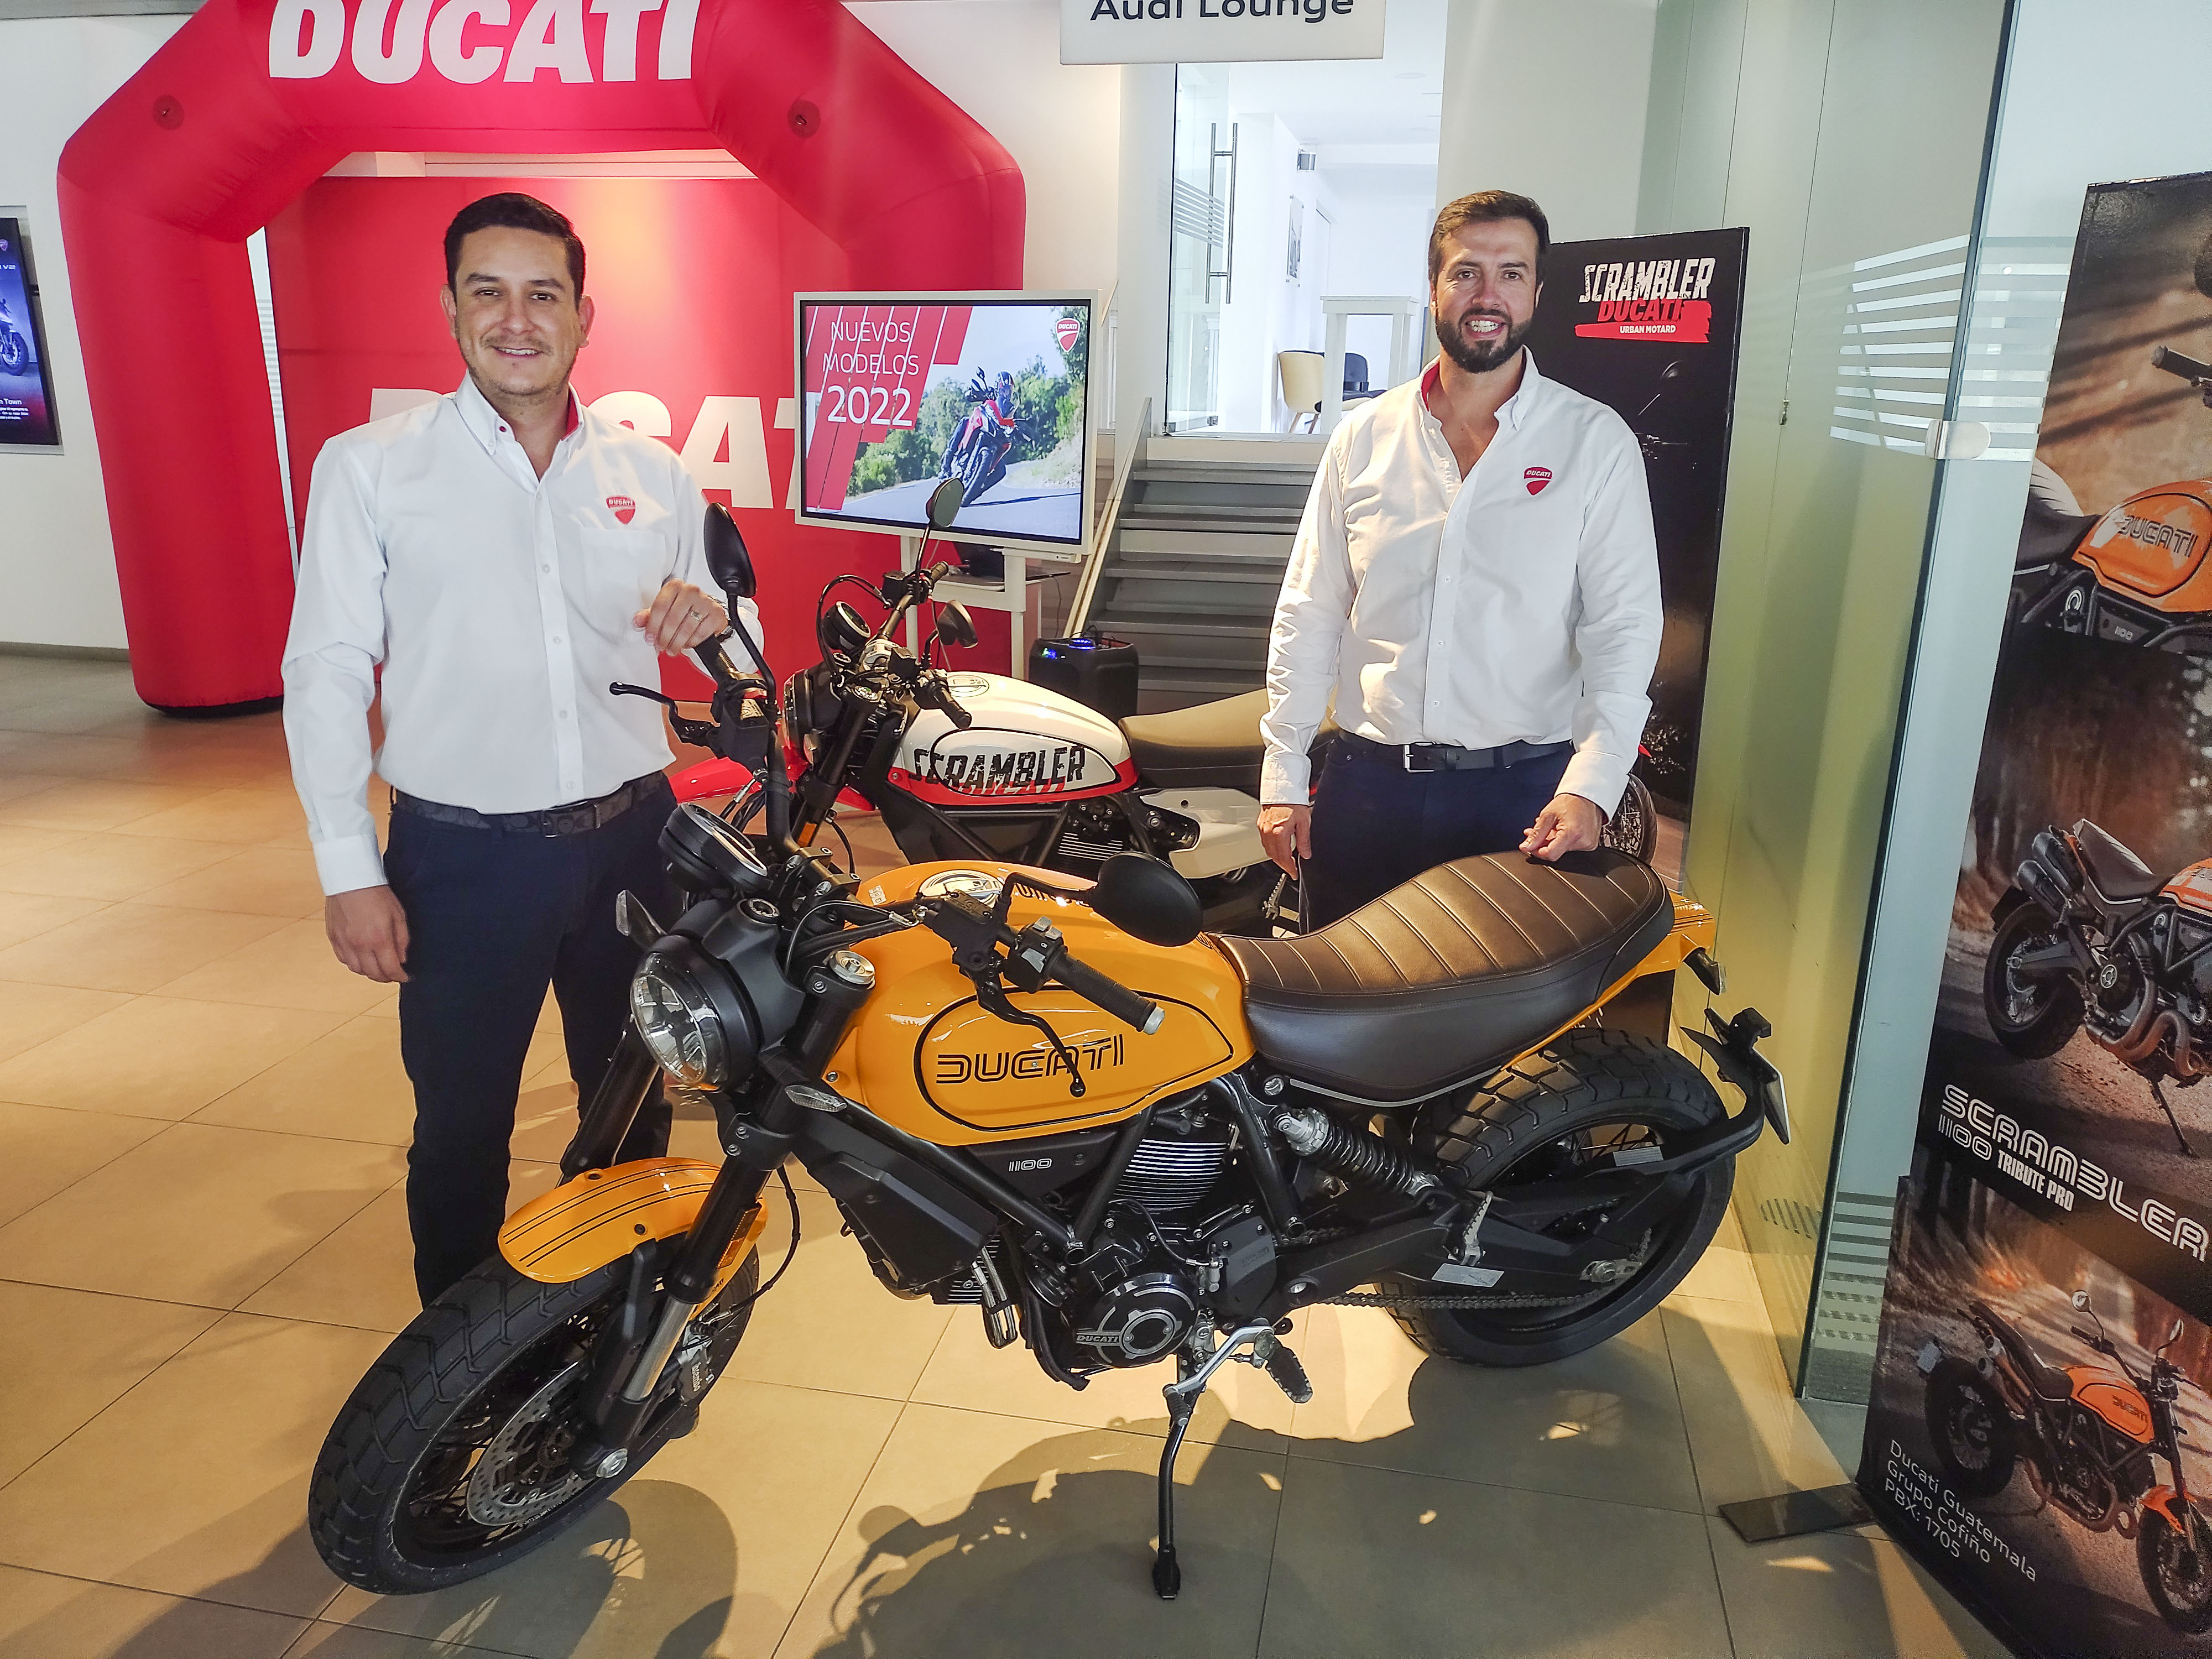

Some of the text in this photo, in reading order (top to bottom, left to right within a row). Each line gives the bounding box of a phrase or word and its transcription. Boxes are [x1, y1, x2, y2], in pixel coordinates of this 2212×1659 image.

[1091, 0, 1354, 23] Audi Lounge
[269, 0, 701, 84] DUCATI
[1578, 257, 1716, 302] SCRAMBLER
[831, 321, 911, 343] NUEVOS
[1598, 298, 1683, 322] DUCATI
[1620, 325, 1676, 333] URBAN MOTARD
[822, 353, 919, 375] MODELOS
[828, 385, 913, 426] 2022
[2118, 515, 2198, 558] DUCATI
[909, 745, 1086, 789] SCRAMBLER
[936, 1034, 1124, 1084] DUCATI
[1008, 1158, 1052, 1172] 1100
[1938, 1114, 2075, 1212] 1100 TRIBUTE PRO
[1942, 1084, 2210, 1263] SCRAMBLER
[1885, 1478, 1960, 1558] PBX: 1705
[1888, 1460, 1990, 1563] Grupo Cofiño
[1891, 1439, 2036, 1582] Ducati Guatemala
